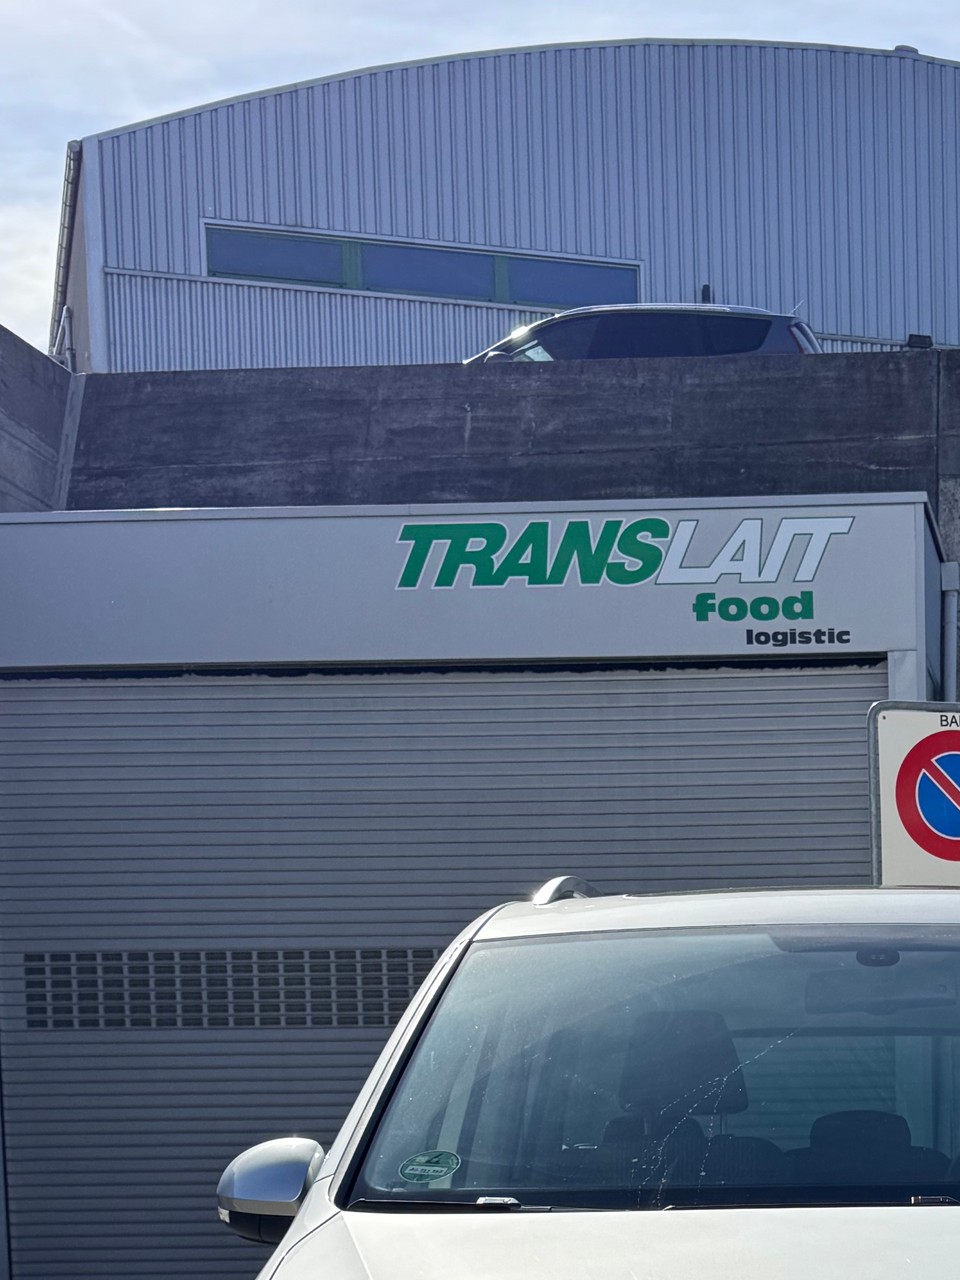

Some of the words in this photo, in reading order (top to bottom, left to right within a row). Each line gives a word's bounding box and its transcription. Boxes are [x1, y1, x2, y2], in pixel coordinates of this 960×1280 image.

[396, 516, 855, 589] TRANSLAIT
[692, 591, 814, 621] food
[745, 628, 851, 647] logistic
